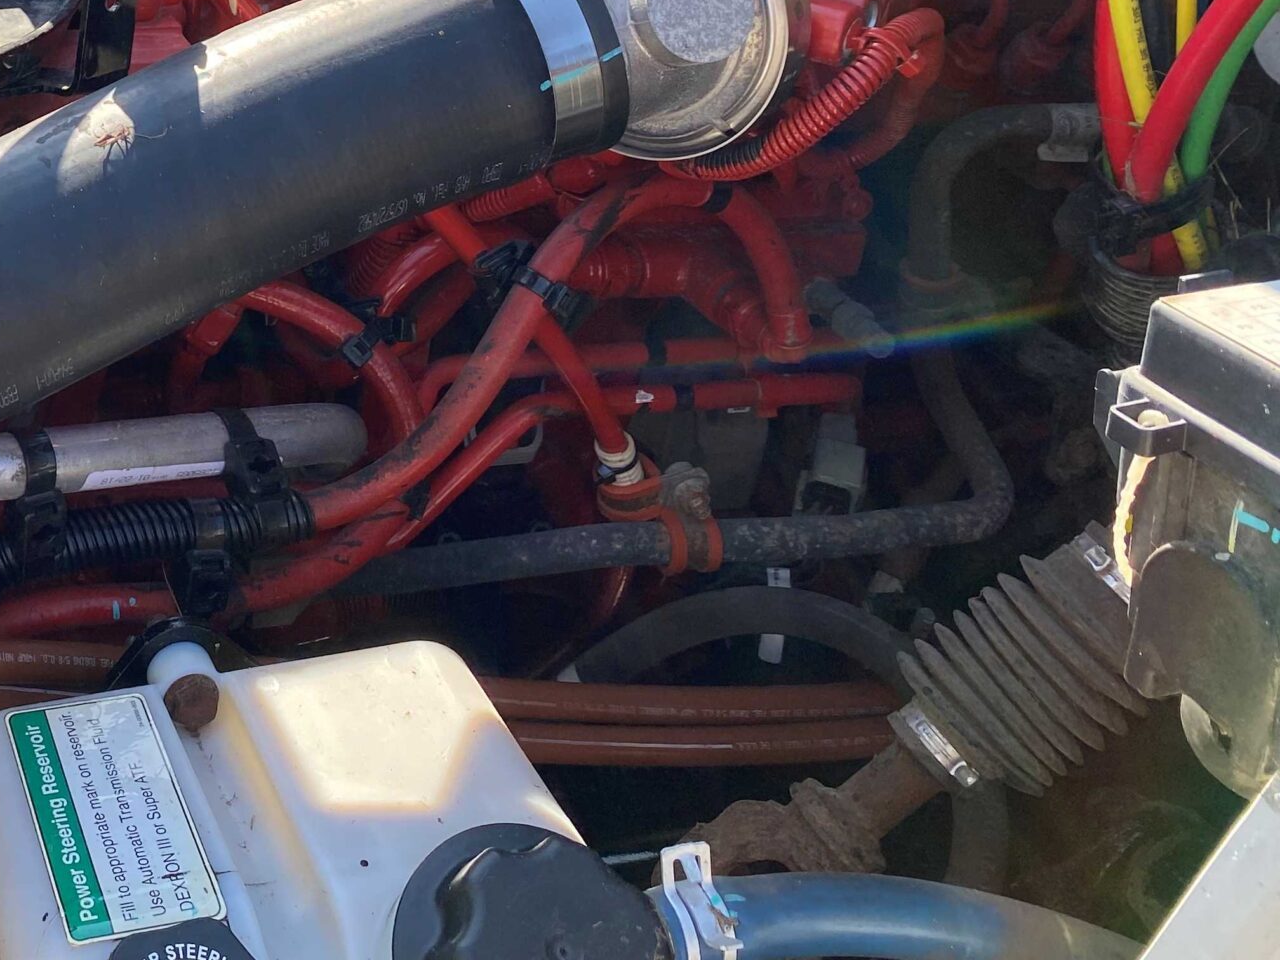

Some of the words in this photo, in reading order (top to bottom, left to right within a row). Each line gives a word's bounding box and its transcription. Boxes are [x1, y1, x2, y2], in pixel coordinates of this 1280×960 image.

[62, 711, 84, 761] reservoir.
[87, 718, 105, 746] Fluid
[25, 725, 60, 795] Reservoir
[77, 763, 91, 778] on
[130, 759, 148, 785] ATF.
[81, 779, 102, 809] mark
[100, 745, 134, 822] Transmission
[144, 788, 162, 821] Super
[49, 800, 80, 865] Steering
[156, 822, 168, 835] or
[93, 812, 127, 883] appropriate
[127, 825, 154, 885] Automatic
[160, 836, 173, 852] III
[72, 869, 98, 922] Power
[118, 885, 130, 899] to
[163, 854, 195, 912] DEXRON
[123, 902, 139, 922] Fill
[148, 889, 167, 917] Use
[164, 943, 228, 960] STEER
